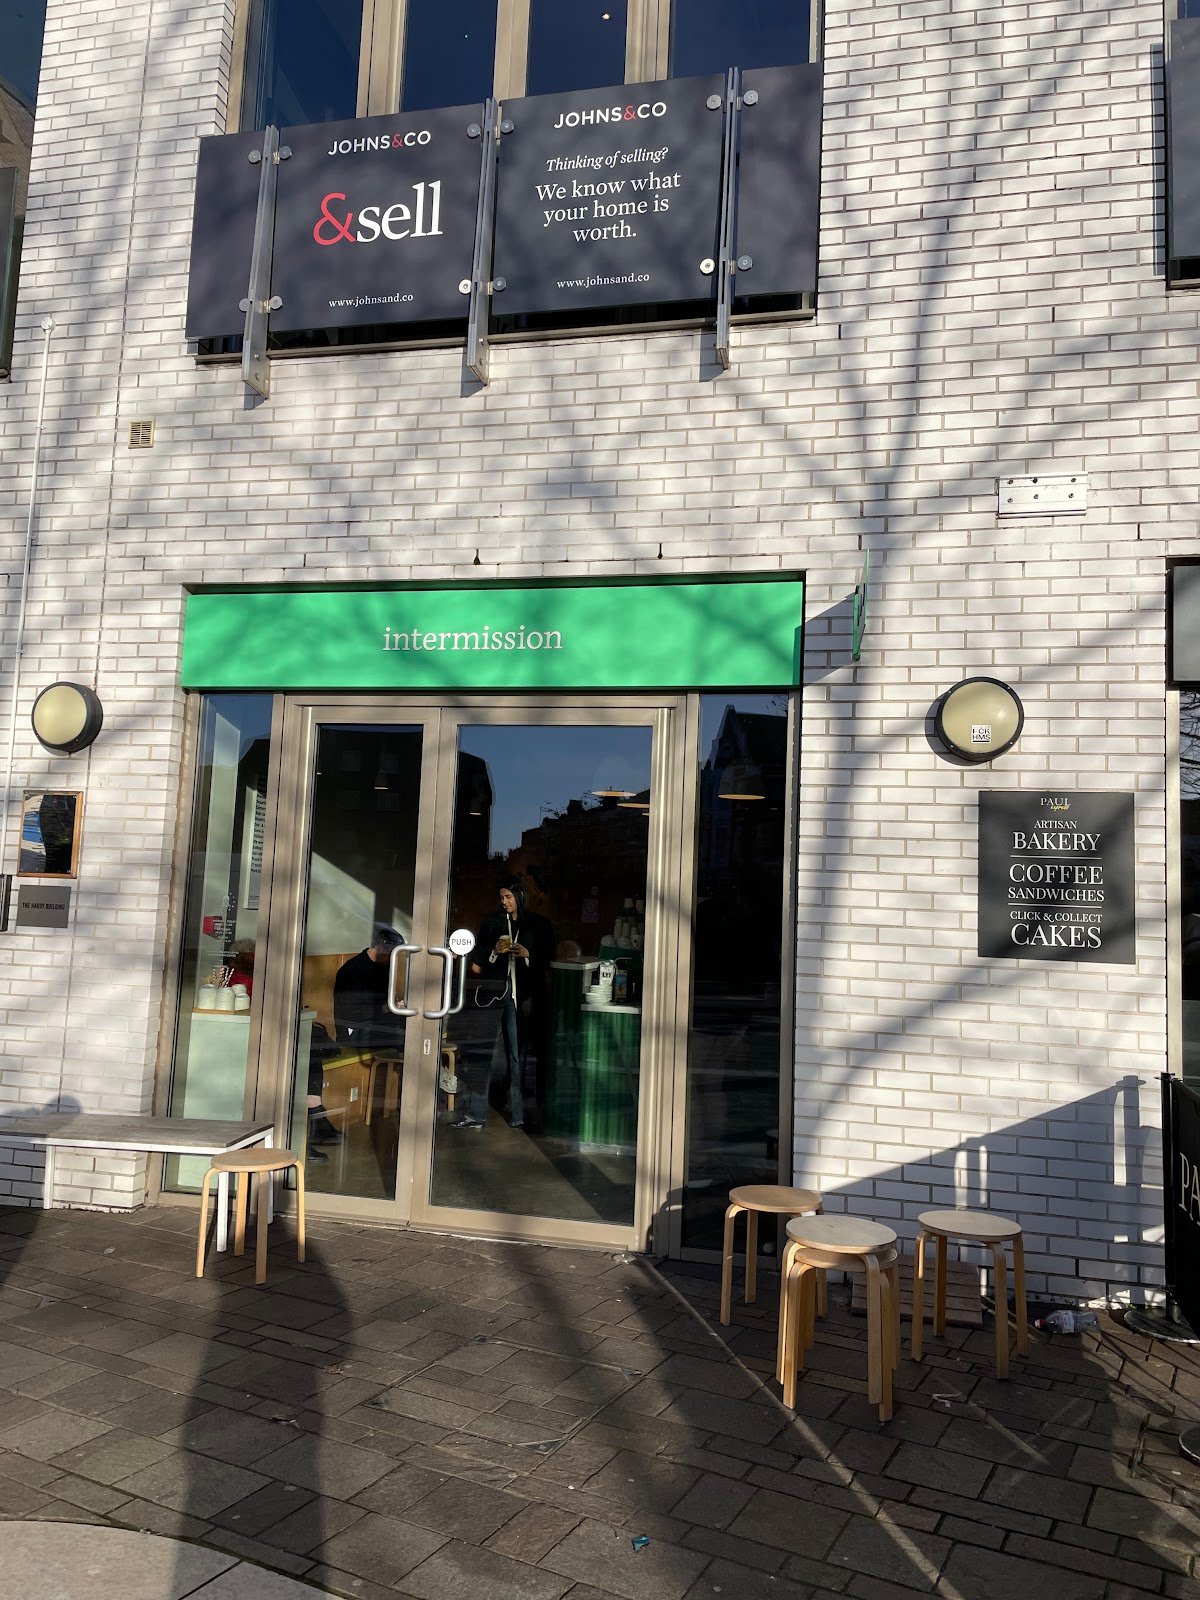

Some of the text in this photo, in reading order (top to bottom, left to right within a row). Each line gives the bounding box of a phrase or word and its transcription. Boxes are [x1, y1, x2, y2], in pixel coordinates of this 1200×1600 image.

[553, 101, 667, 129] JOHNS&CO
[327, 130, 432, 156] JOHNS&CO
[545, 146, 669, 172] Thinking of selling?
[535, 171, 682, 201] We know what
[313, 179, 444, 246] &sell
[543, 194, 670, 228] your home is
[572, 219, 637, 242] worth.
[556, 272, 650, 289] www.johnsand.co
[328, 292, 414, 308] www.johnsand.co
[382, 624, 563, 651] intermission
[1040, 797, 1071, 806] PAUL
[1034, 820, 1078, 829] ARTISAN
[1012, 831, 1101, 851] BAKERY
[1009, 863, 1104, 885] COFFEE
[1008, 886, 1105, 902] SANDWICHES
[1010, 910, 1103, 923] CLICK & COLLECT
[451, 938, 472, 946] PUSH
[1010, 922, 1102, 949] CAKES
